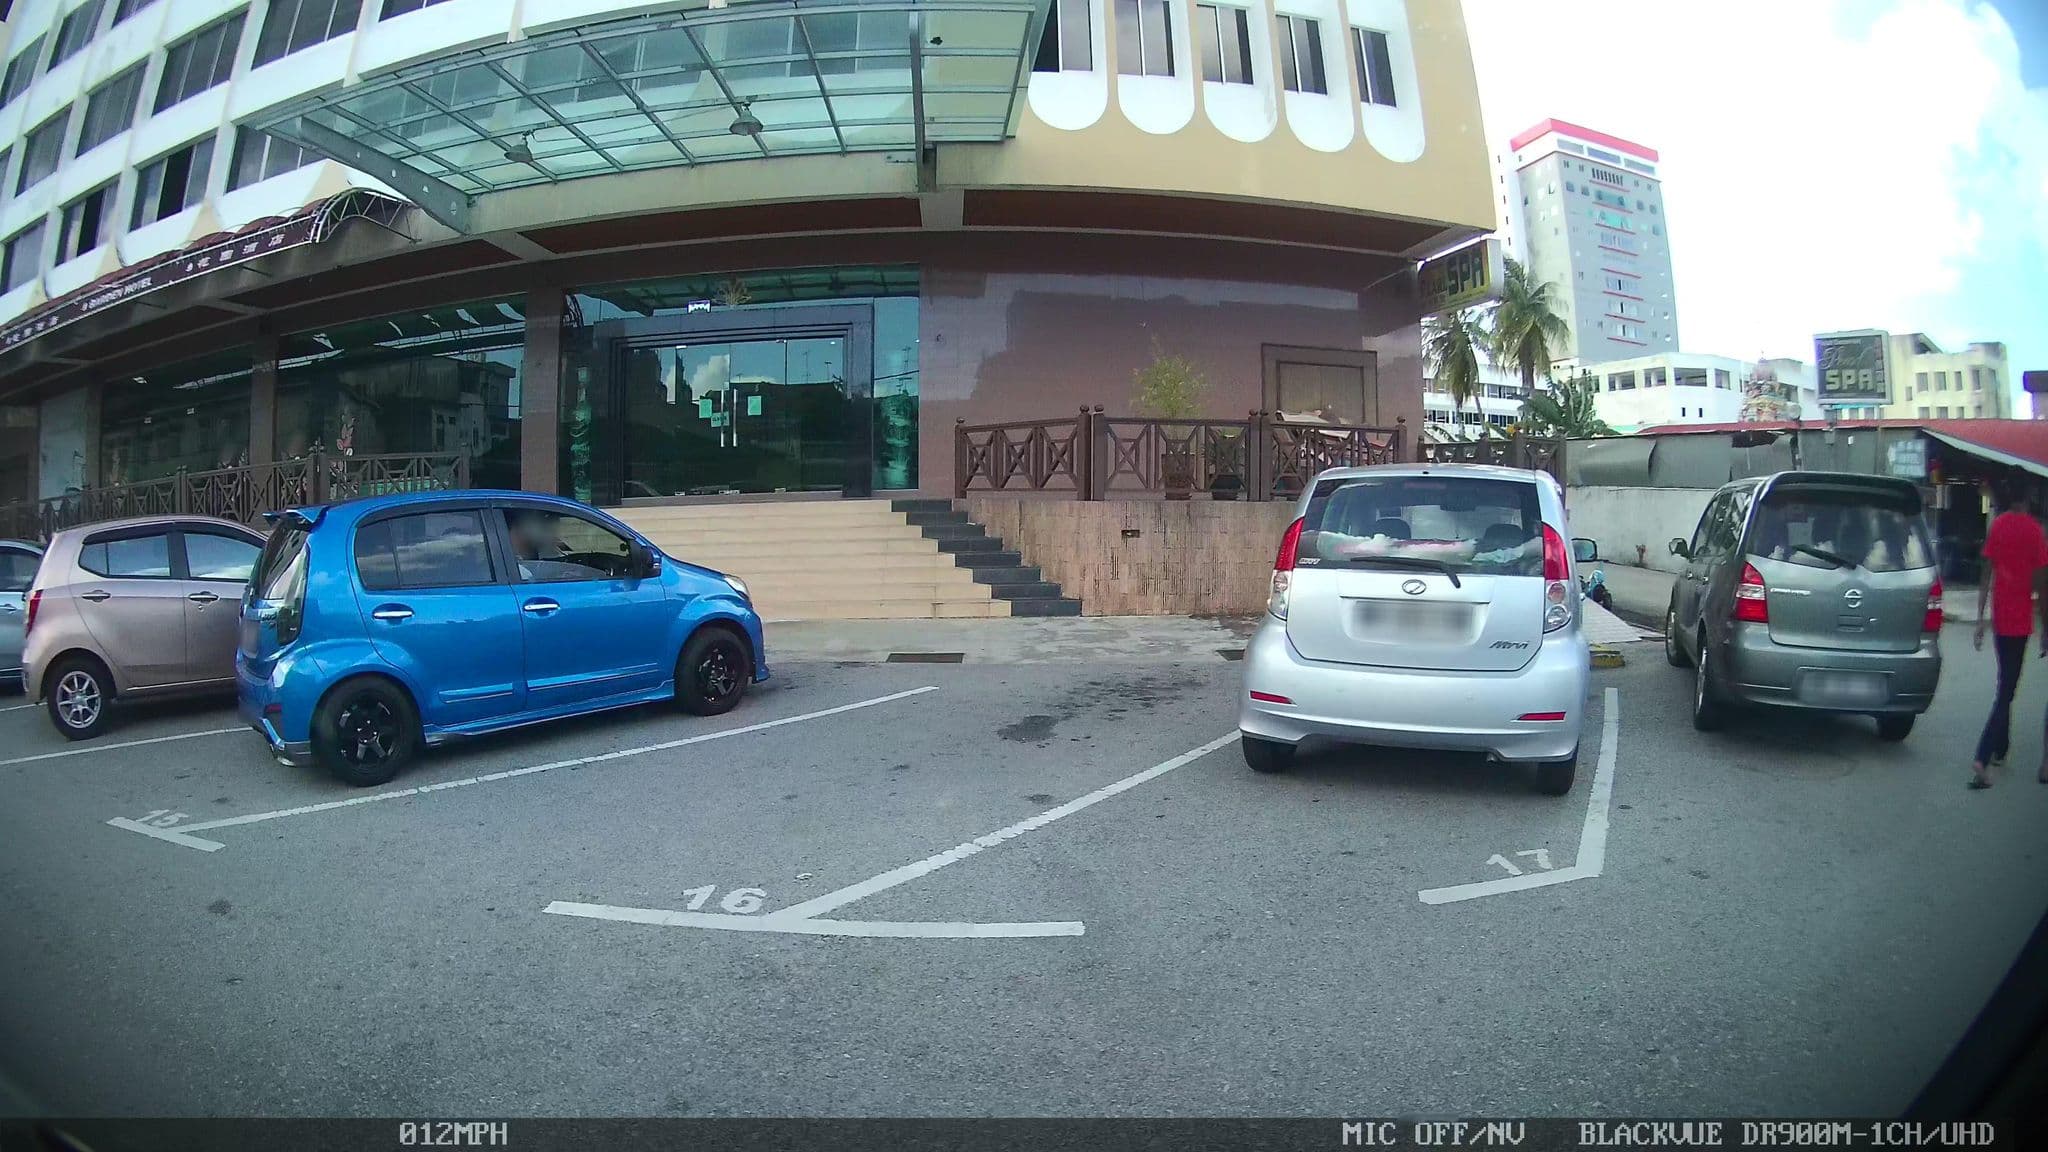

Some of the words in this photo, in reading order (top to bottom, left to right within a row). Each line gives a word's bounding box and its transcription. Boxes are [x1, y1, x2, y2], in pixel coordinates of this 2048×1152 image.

[1825, 369, 1875, 391] SPA
[1486, 848, 1554, 876] 17
[683, 884, 768, 914] 16
